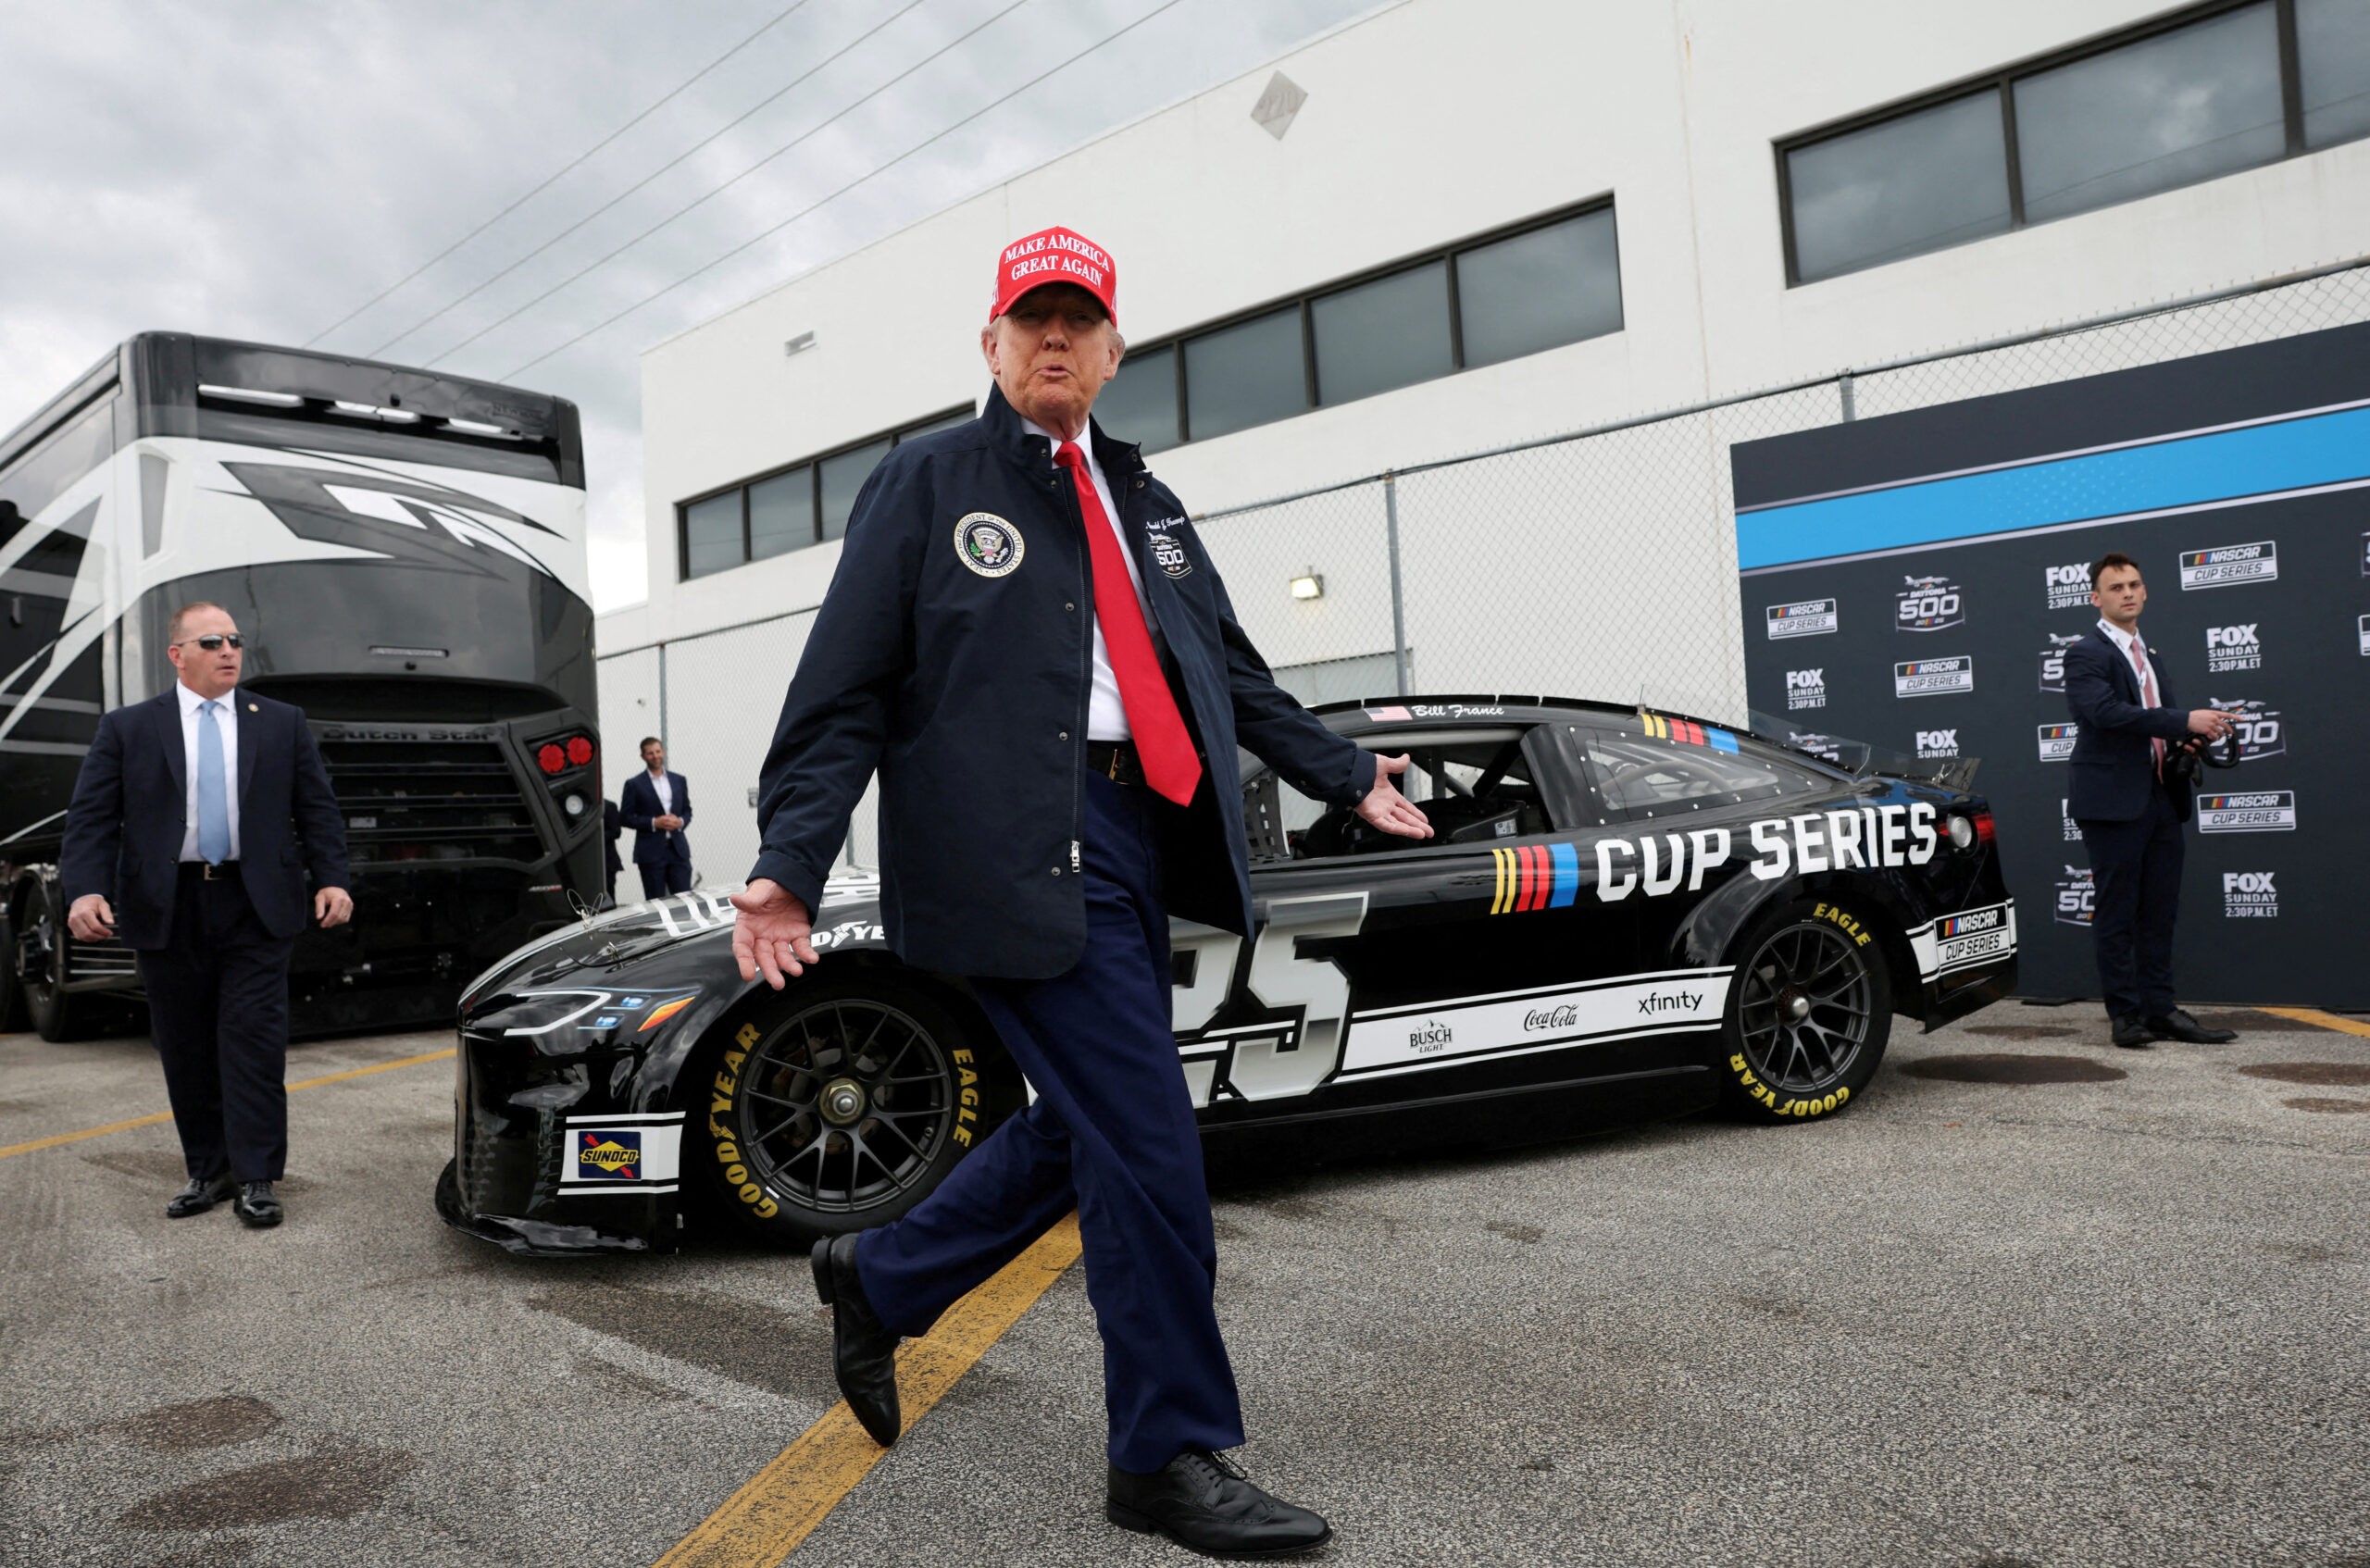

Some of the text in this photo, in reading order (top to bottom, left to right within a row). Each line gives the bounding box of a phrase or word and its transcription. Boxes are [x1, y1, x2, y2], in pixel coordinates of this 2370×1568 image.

[1004, 234, 1110, 273] MAKE AMERICA
[1011, 255, 1103, 289] GREAT AGAIN
[957, 515, 985, 538] PRESIDENT
[1155, 549, 1184, 566] 500
[2210, 546, 2261, 564] NASCAR
[2046, 562, 2091, 587] FOX
[2194, 563, 2263, 580] CUP SERIES
[1910, 588, 1946, 599] DAYTONA
[2047, 583, 2092, 595] SUNDAY
[1789, 603, 1826, 616] NASCAR
[1899, 594, 1960, 620] 500
[1778, 617, 1827, 630] CUP SERIES
[2206, 623, 2259, 648] FOX
[2208, 644, 2260, 658] SUNDAY
[1919, 660, 1960, 674] NASCAR
[1787, 668, 1825, 690] FOX
[1907, 675, 1961, 689] CUP SERIES
[1788, 687, 1825, 697] SUNDAY
[1411, 704, 1504, 718] Bill France
[324, 725, 498, 740] Dutch Star
[1916, 729, 1958, 750] FOX
[1917, 748, 1959, 758] SUNDAY
[2052, 742, 2073, 753] CUP
[2227, 795, 2279, 808] NASCAR
[2213, 812, 2280, 824] CUP SERIES
[1595, 802, 1937, 902] CUP SERIES
[2223, 872, 2276, 893] FOX
[2225, 893, 2277, 902] SUNDAY
[1813, 902, 1871, 947] EAGLE
[1957, 910, 1999, 934] NASCAR
[1946, 934, 2000, 960] CUP SERIES
[1638, 990, 1703, 1015] xfinity
[1409, 1027, 1453, 1048] BUSCH
[1418, 1043, 1444, 1053] LIGHT
[953, 1048, 979, 1148] EAGLE
[582, 1150, 638, 1164] SUNOCO
